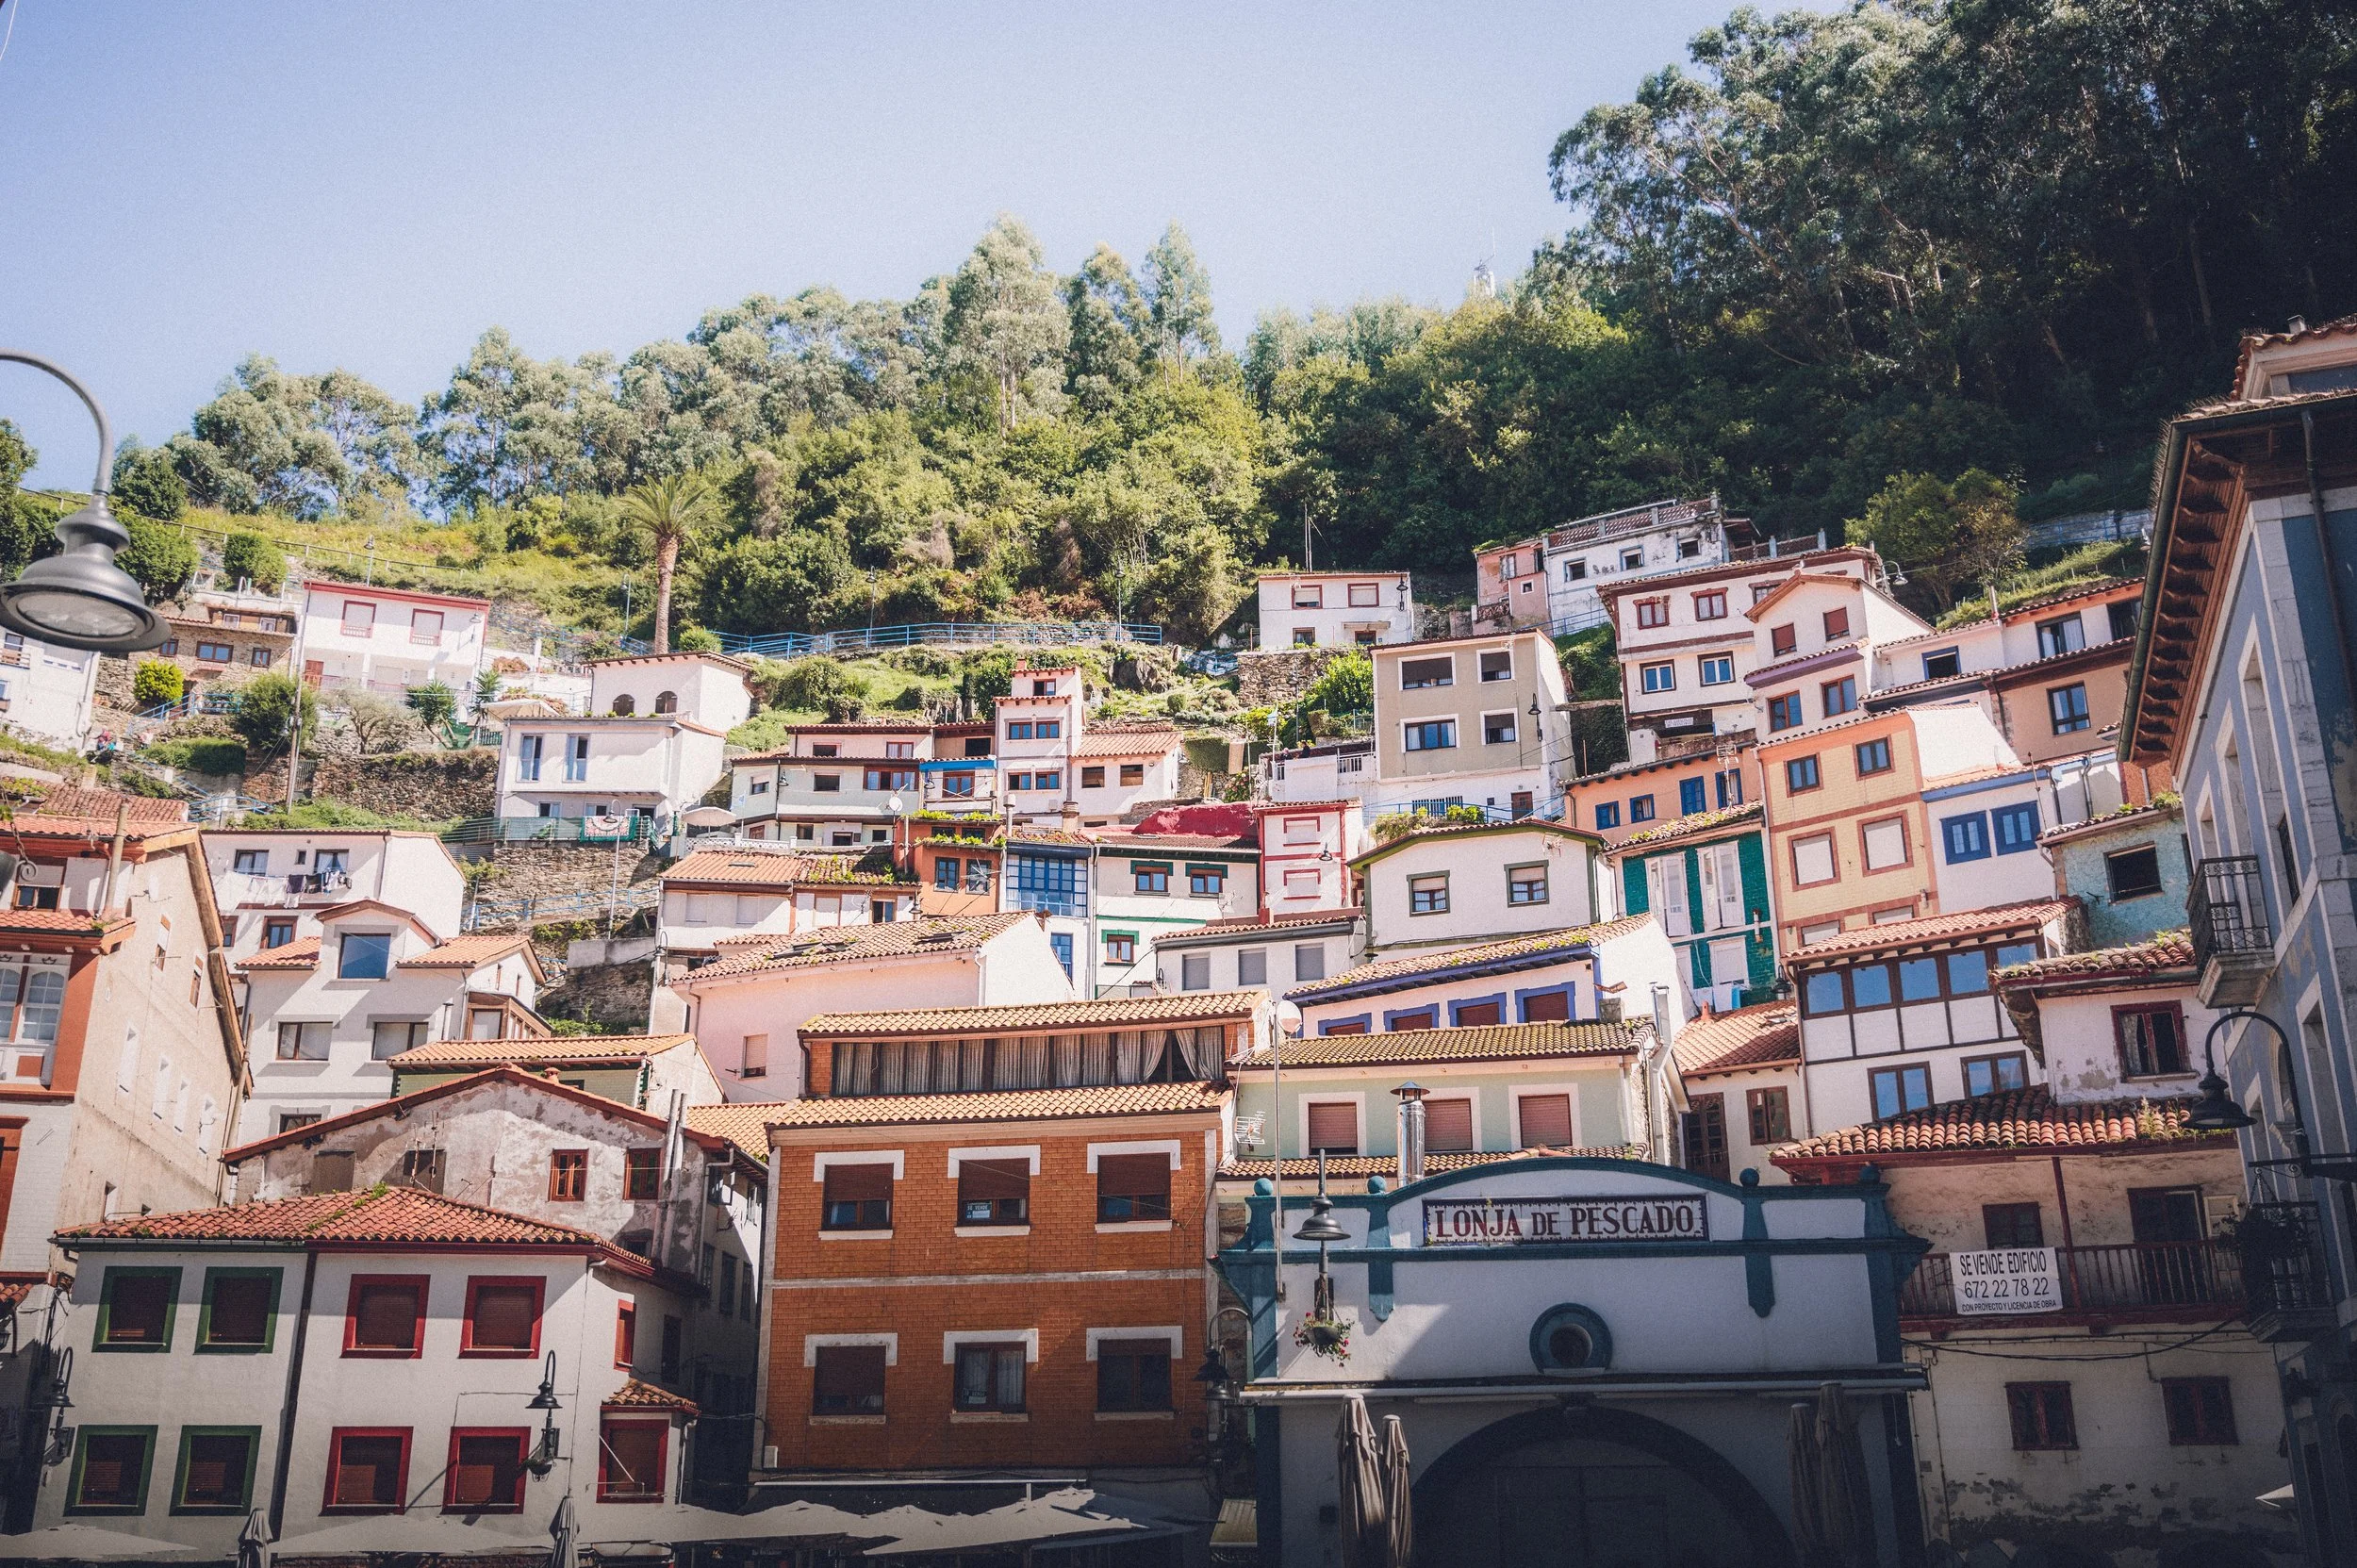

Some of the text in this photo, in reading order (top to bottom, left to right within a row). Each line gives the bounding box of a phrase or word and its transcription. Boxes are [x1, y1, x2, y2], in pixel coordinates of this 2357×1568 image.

[1435, 1205, 1694, 1237] LONJA DE PESCADO
[1960, 1251, 2047, 1276] SE VENDE EDIFICIO
[1964, 1277, 2050, 1298] 672 22 78 22
[1962, 1299, 2057, 1312] CON PROYECTO Y LICENCIA DE OBRA
